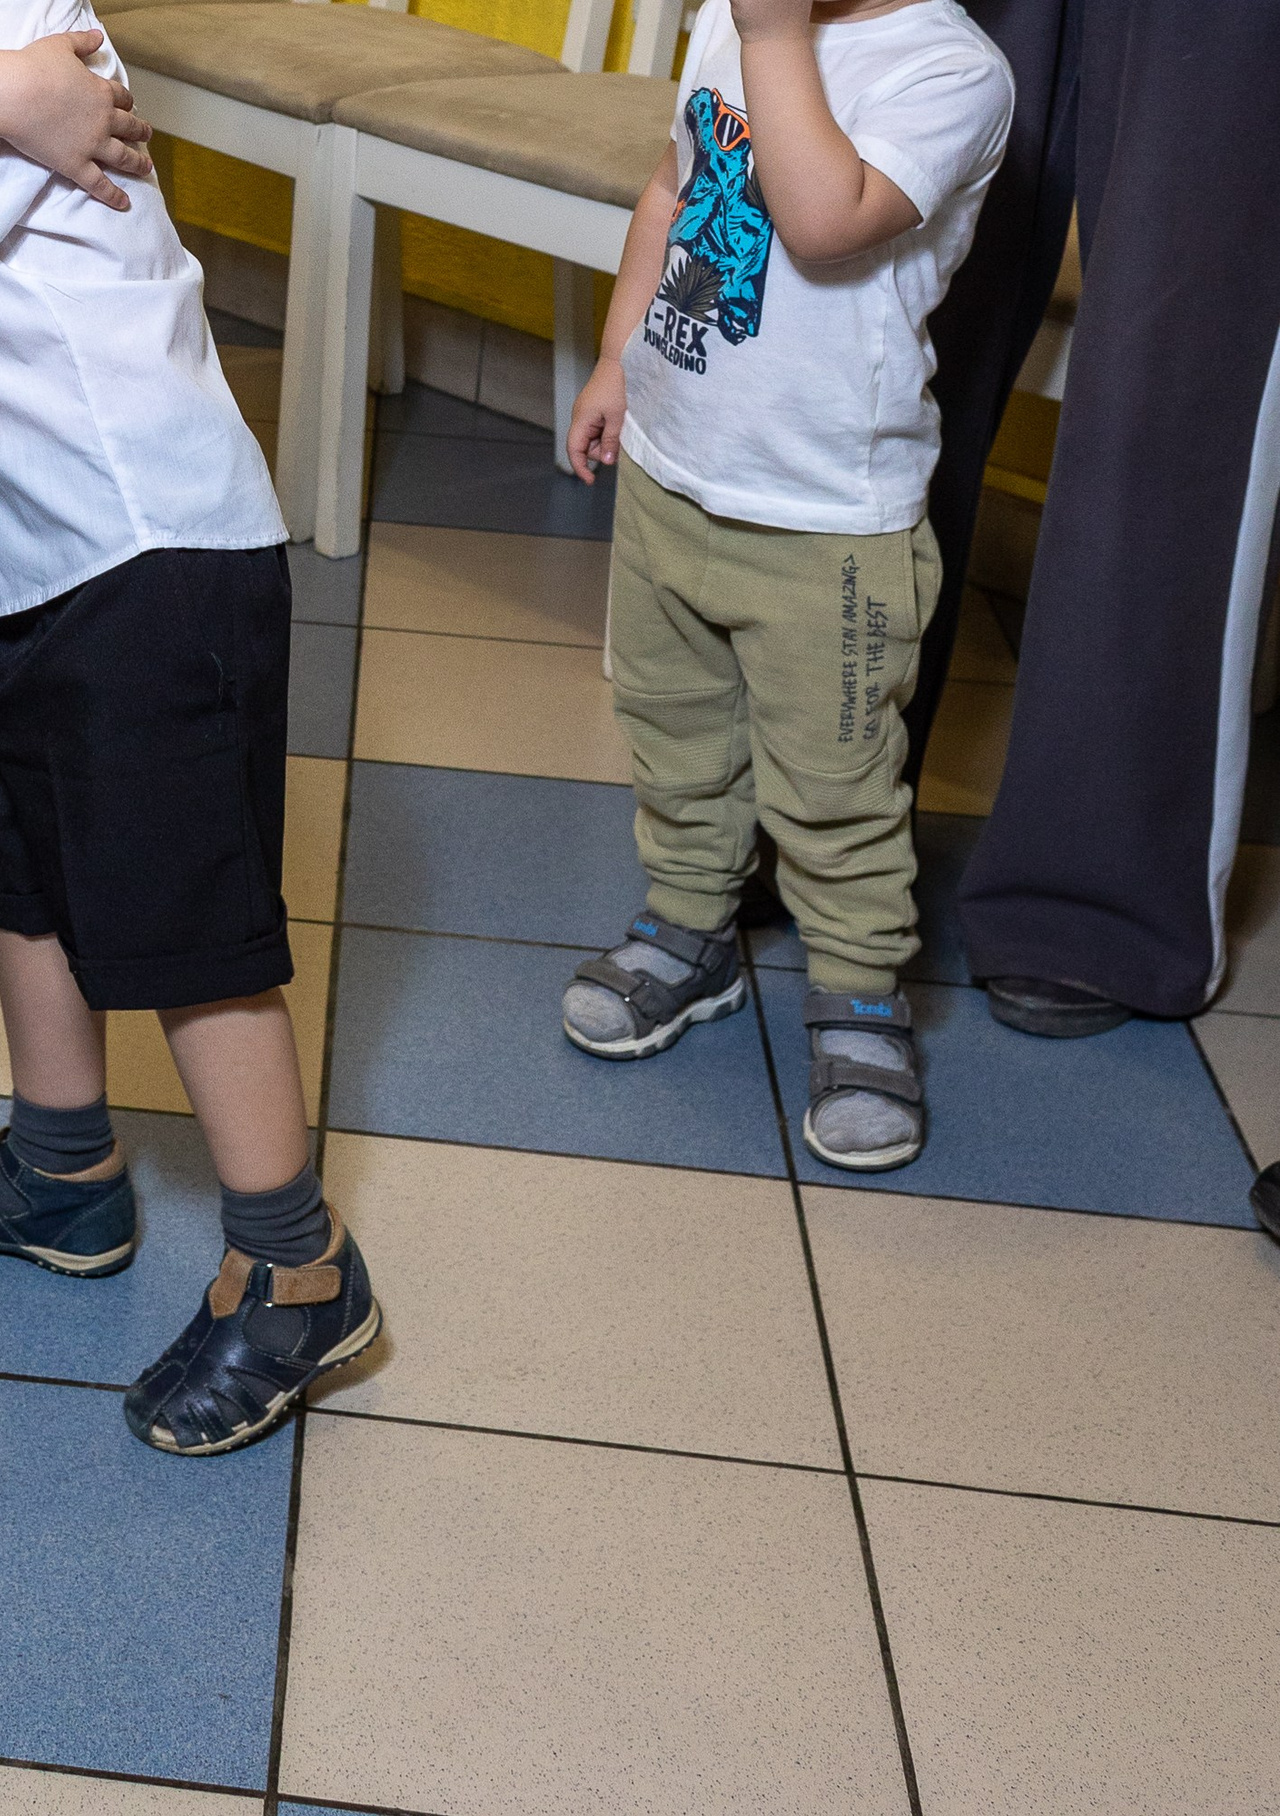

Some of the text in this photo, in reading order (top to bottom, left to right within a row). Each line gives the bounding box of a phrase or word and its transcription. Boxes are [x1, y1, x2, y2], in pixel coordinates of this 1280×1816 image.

[643, 326, 707, 375] JUNGLEDINO
[866, 595, 887, 637] BEST
[841, 624, 858, 656] STAY
[866, 638, 884, 676] THE
[838, 661, 858, 744] EVERYWHERE
